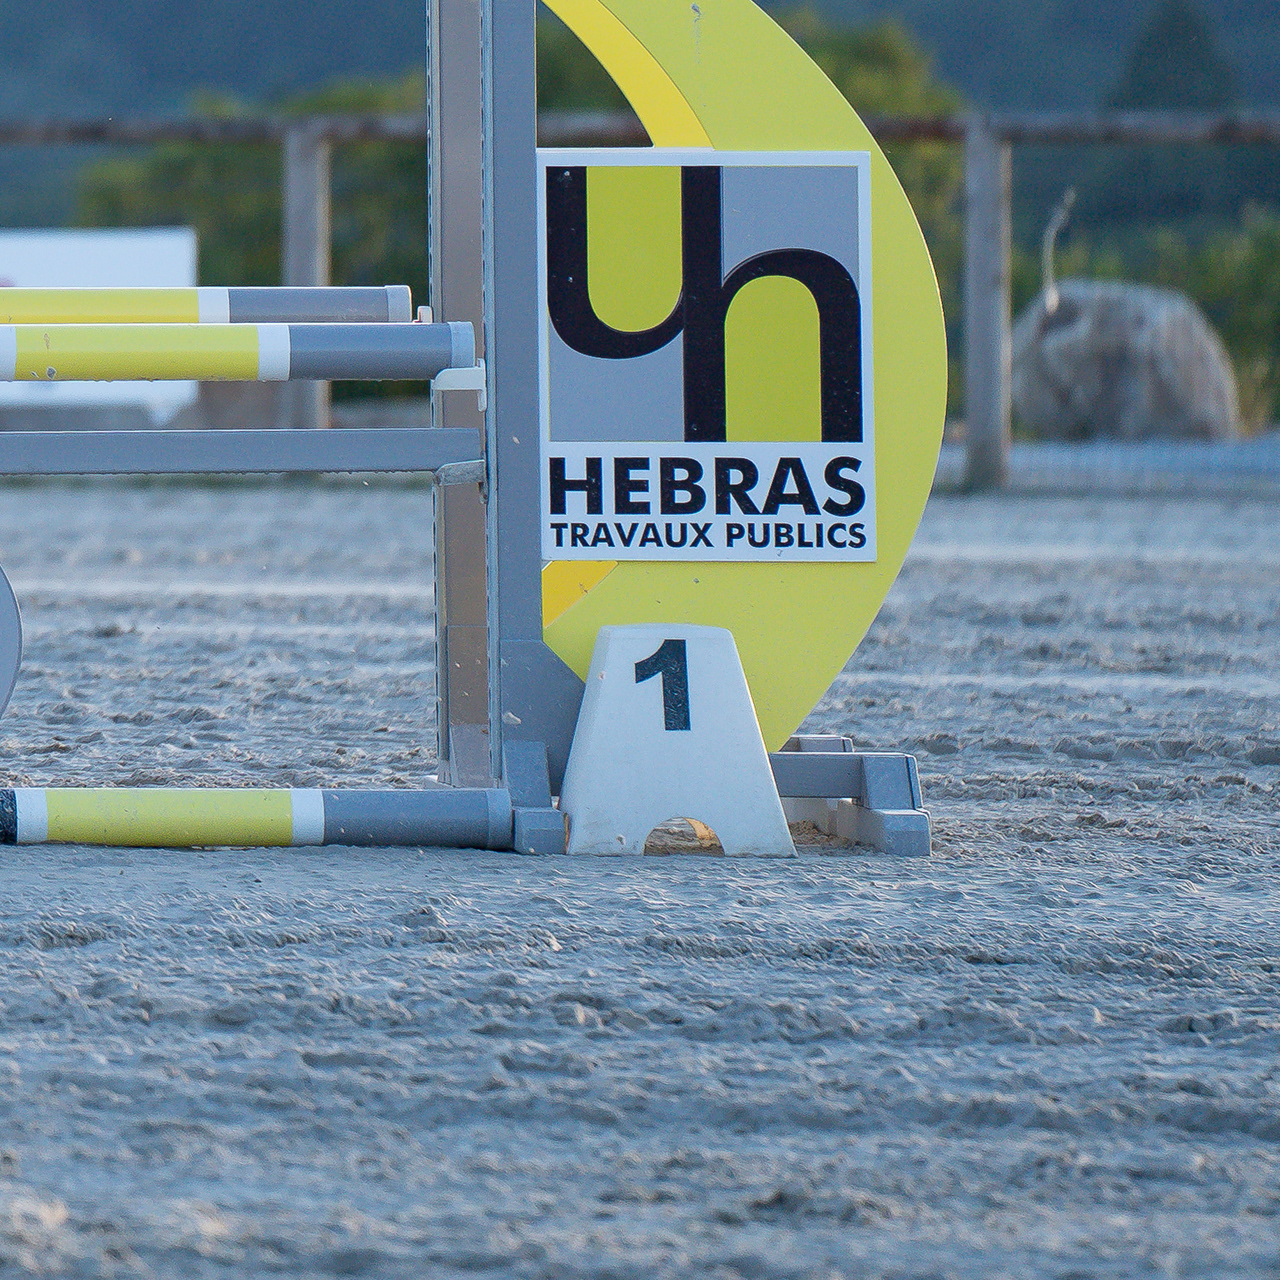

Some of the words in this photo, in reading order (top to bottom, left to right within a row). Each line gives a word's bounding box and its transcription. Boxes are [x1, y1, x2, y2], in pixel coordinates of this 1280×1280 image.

[548, 456, 866, 517] HEBRAS
[550, 523, 714, 548] TRAVAUX
[726, 523, 866, 548] PUBLICS
[634, 639, 691, 731] 1
